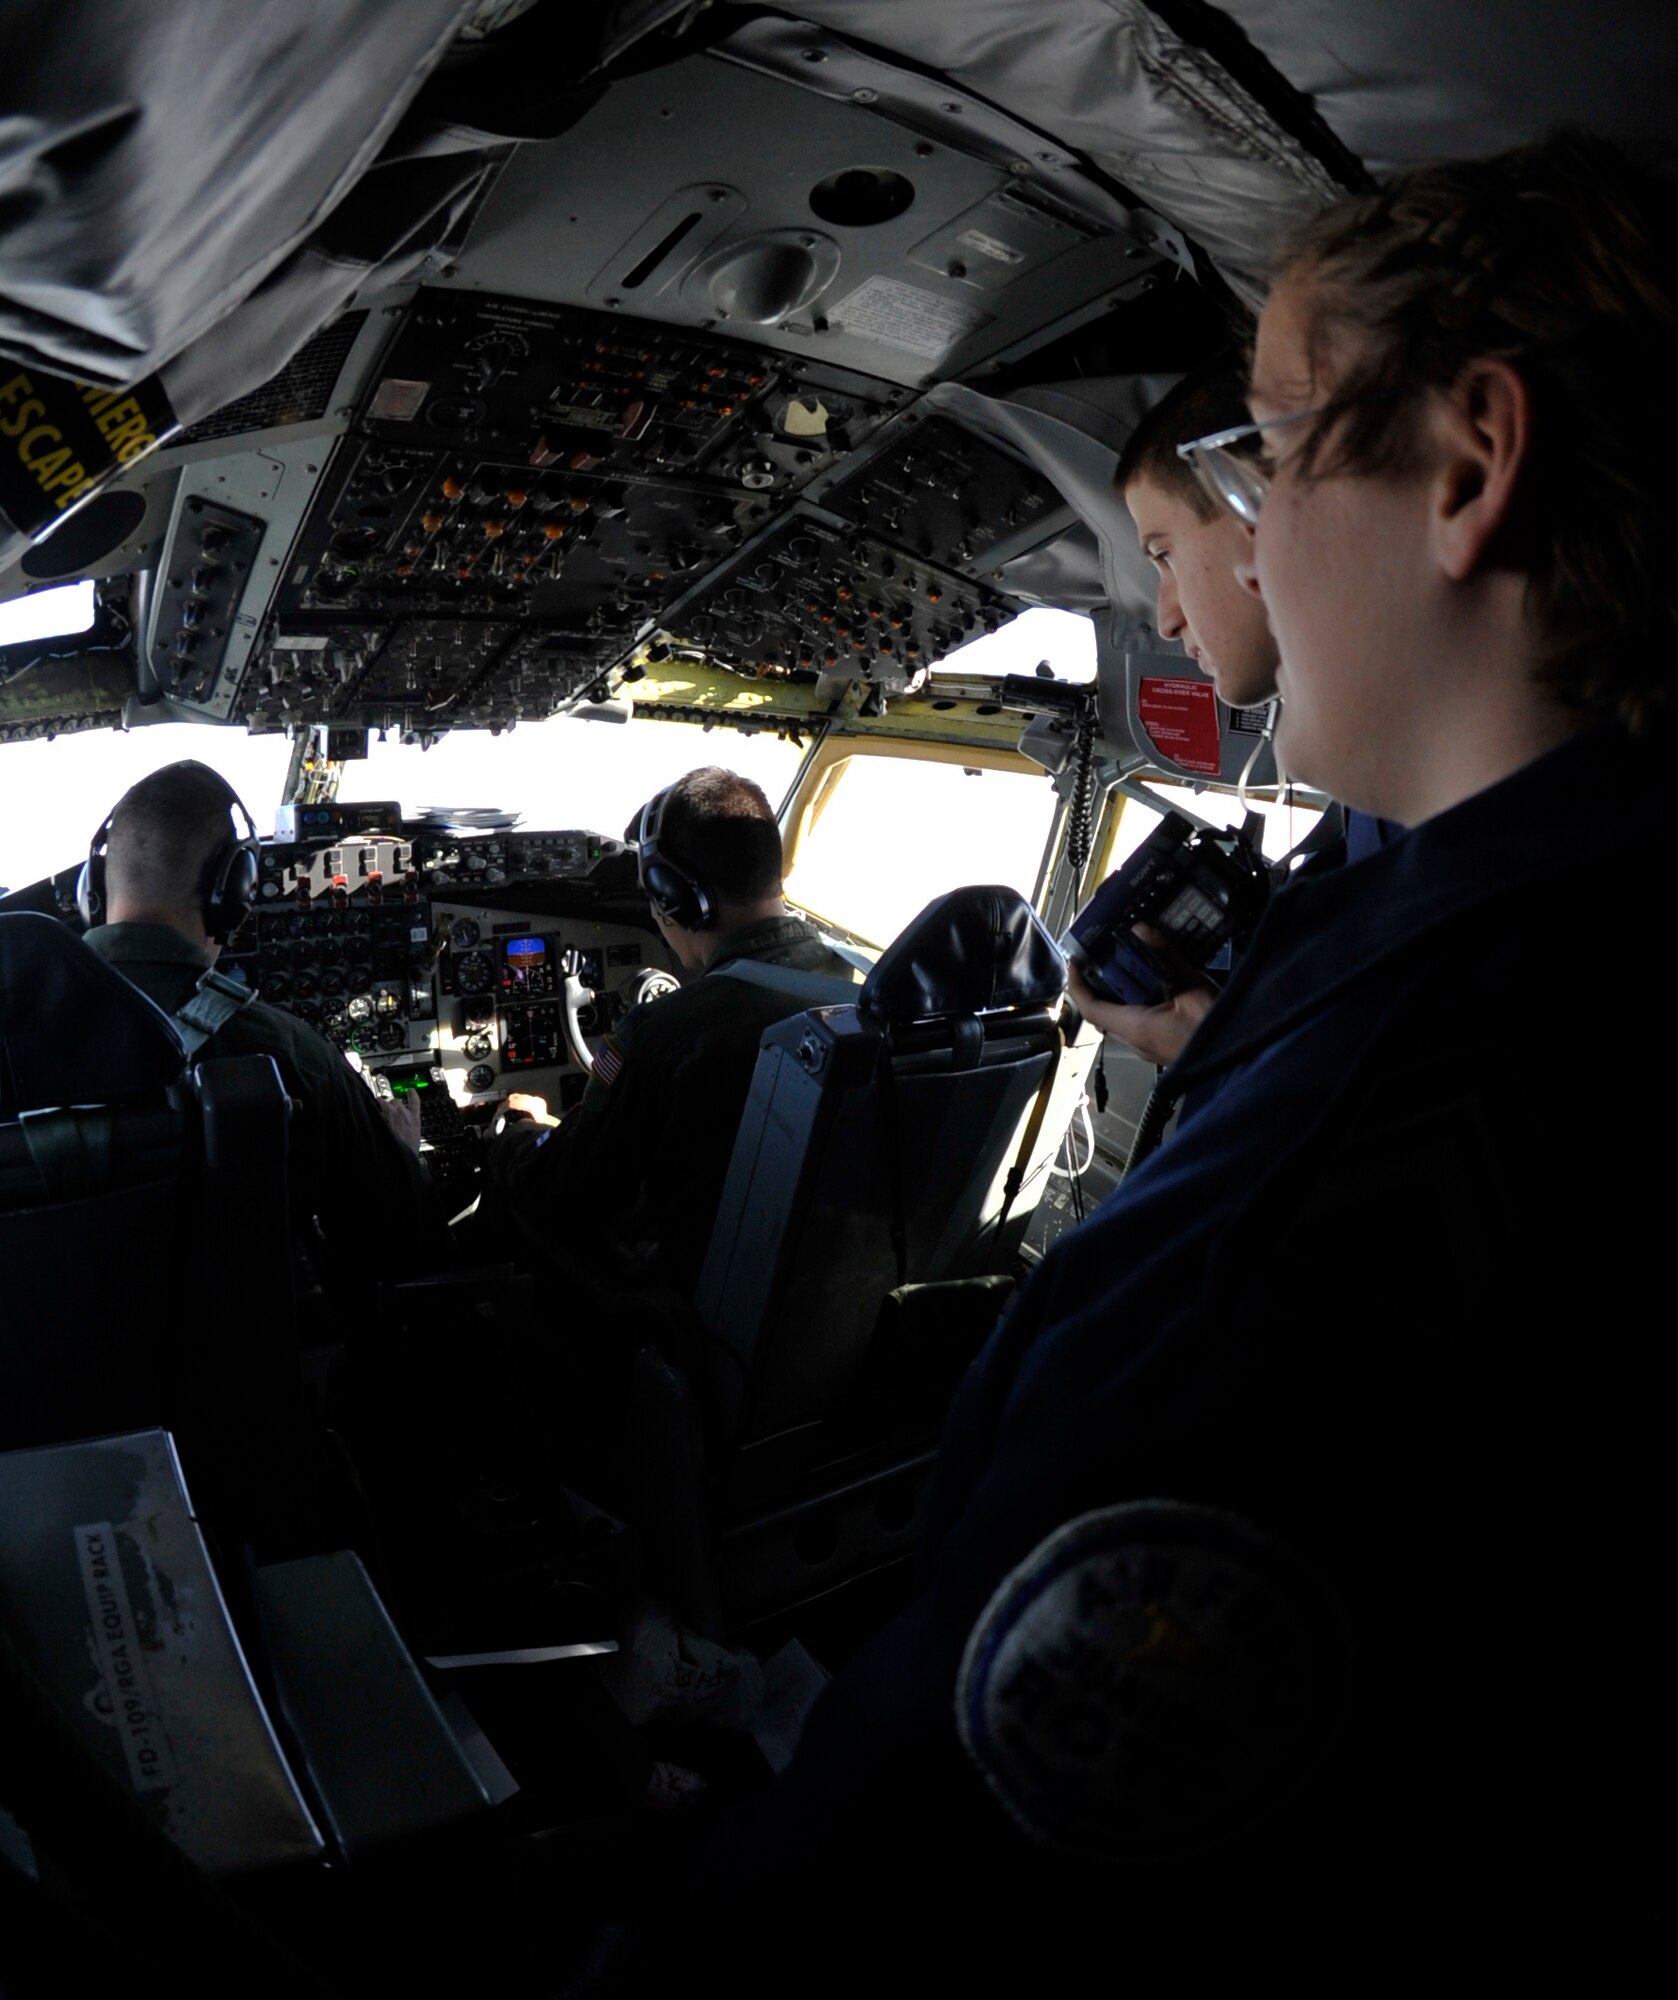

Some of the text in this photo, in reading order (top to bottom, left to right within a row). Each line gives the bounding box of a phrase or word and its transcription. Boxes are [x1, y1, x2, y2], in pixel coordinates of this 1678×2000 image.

[74, 384, 157, 463] MERG
[1152, 687, 1210, 698] CROSS-OVER VALVE
[1164, 682, 1198, 691] HYDRAULIC
[1130, 858, 1155, 888] SONY
[1079, 1556, 1174, 1620] AIR
[87, 1533, 160, 1777] FD-109/RGA EQUIP RACK
